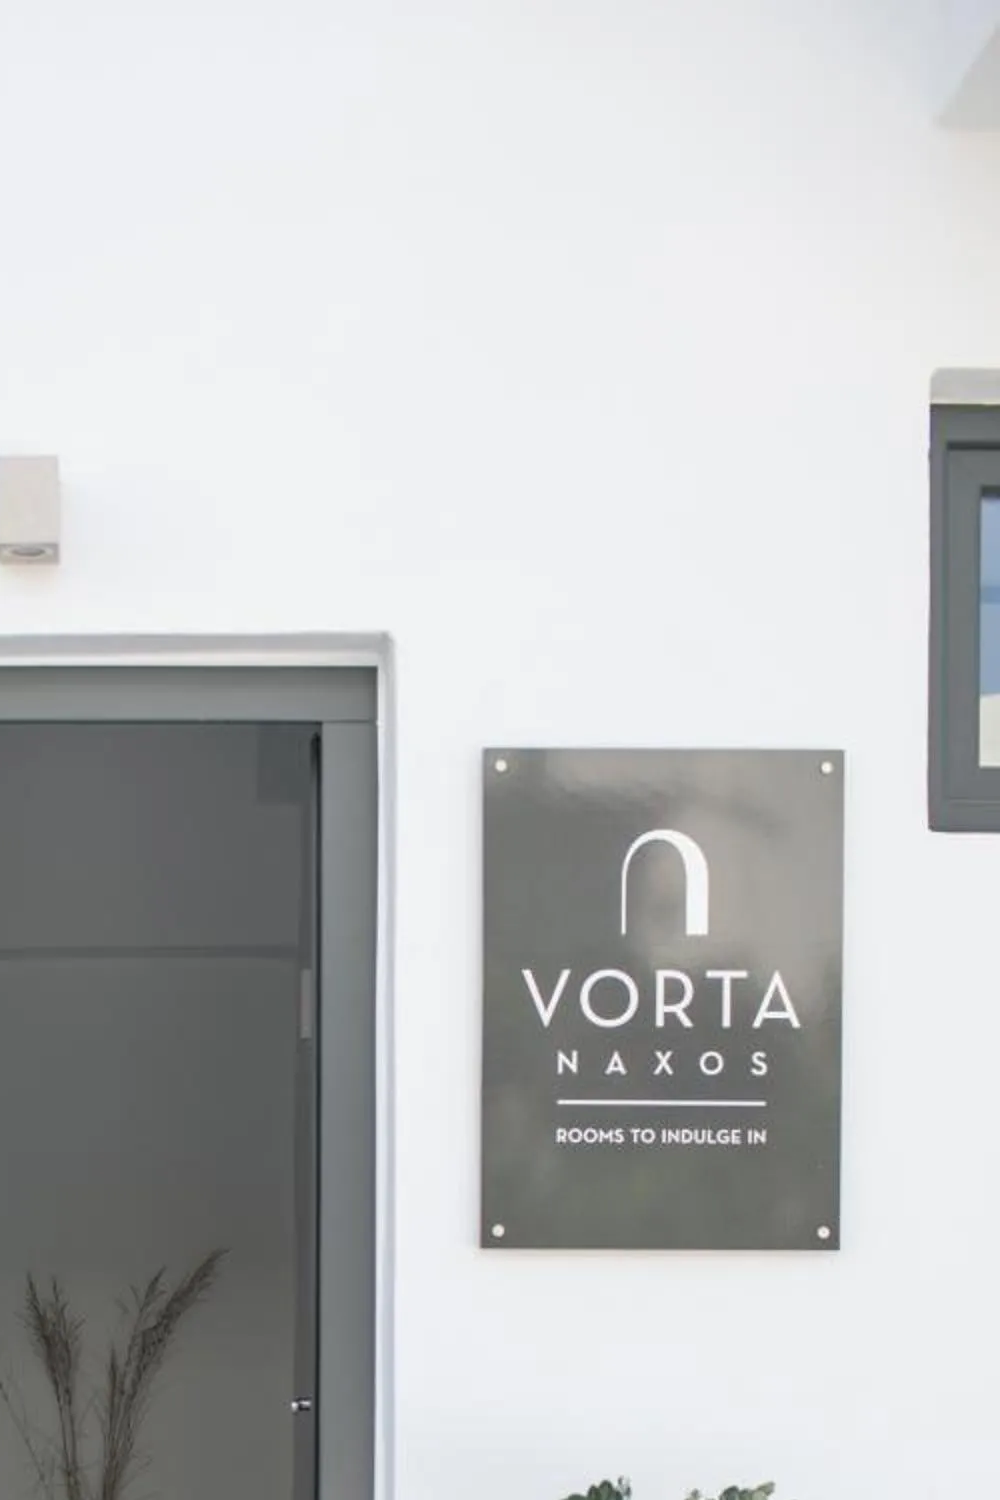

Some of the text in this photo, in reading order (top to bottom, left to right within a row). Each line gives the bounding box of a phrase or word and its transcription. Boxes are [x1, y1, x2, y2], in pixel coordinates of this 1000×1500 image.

[521, 968, 801, 1029] VORTA
[557, 1050, 768, 1076] NAXOS
[555, 1127, 767, 1145] ROOMS TO INDULGE IN
